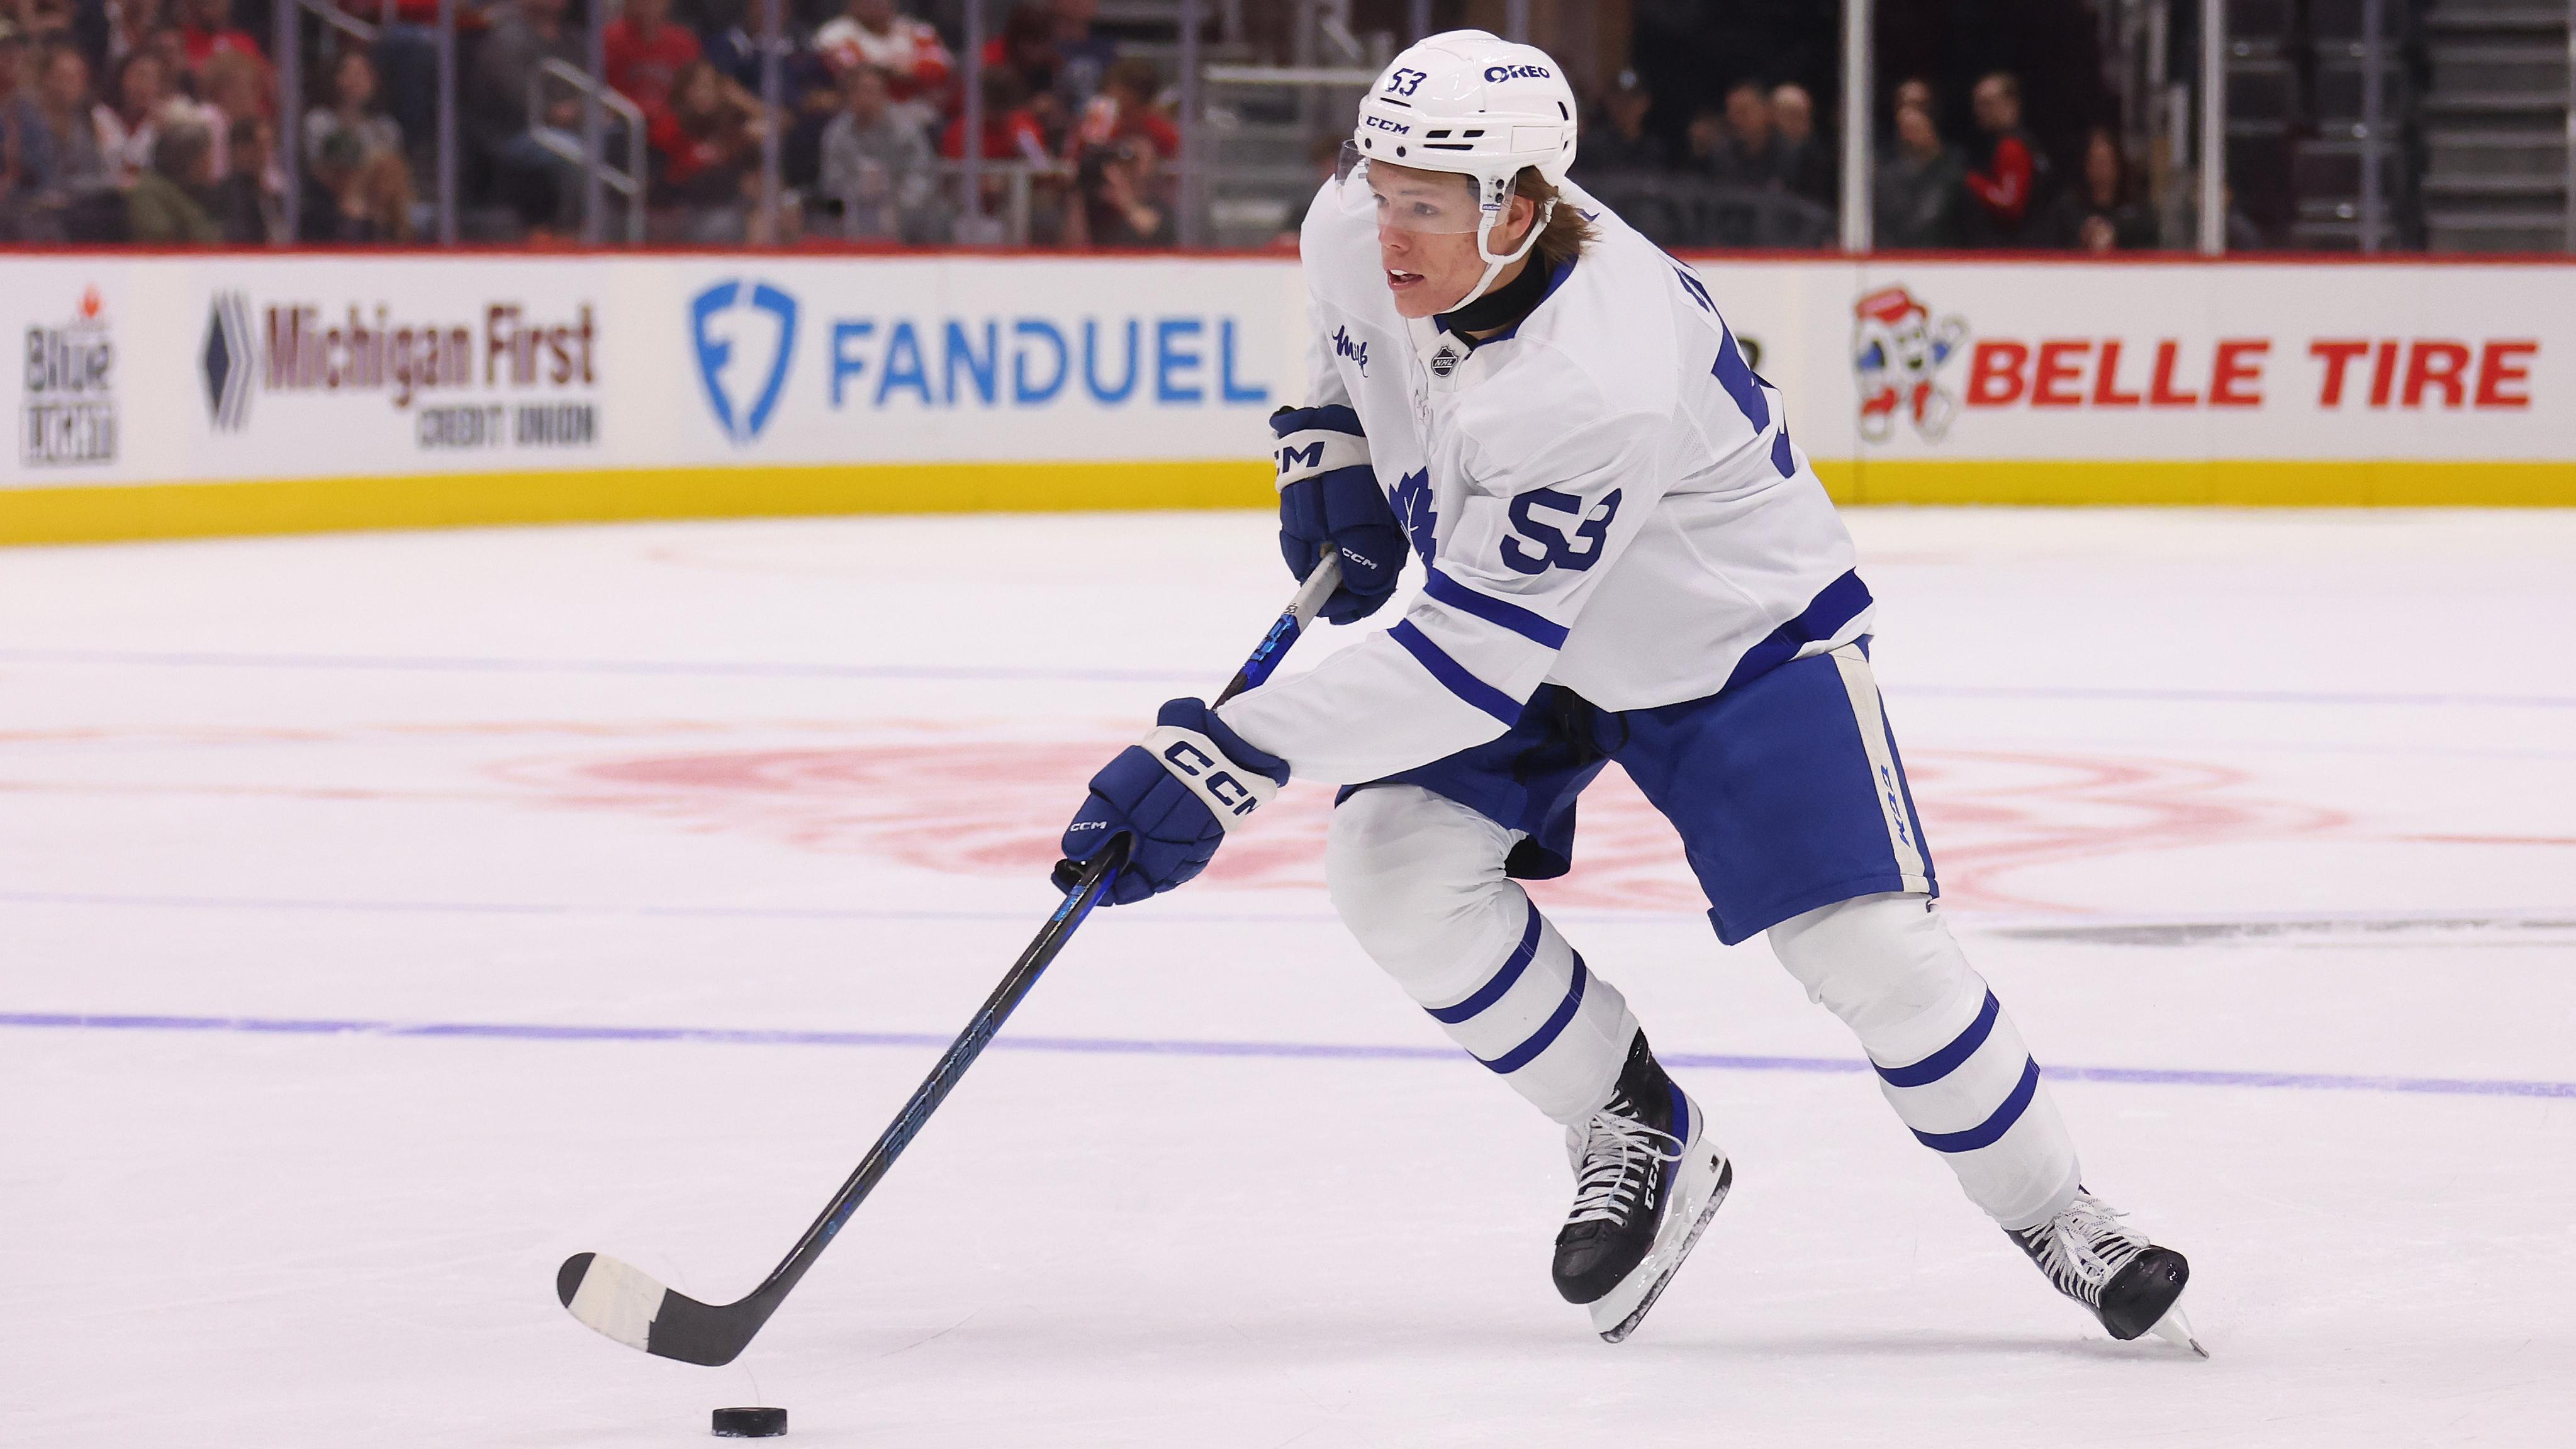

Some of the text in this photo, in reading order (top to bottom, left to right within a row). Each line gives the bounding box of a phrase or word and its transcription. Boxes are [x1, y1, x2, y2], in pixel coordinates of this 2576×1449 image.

[1385, 67, 1427, 96] 53
[1484, 65, 1550, 83] OREO
[1366, 115, 1410, 135] CCM
[264, 303, 593, 408] Michigan First
[829, 319, 1268, 406] FANDUEL
[1434, 359, 1453, 367] NHL
[1963, 338, 2540, 410] BELLE TIRE
[1499, 487, 1622, 575] 53
[1341, 547, 1378, 569] CCM
[1881, 764, 1911, 848] CCM
[1070, 820, 1107, 832] CCM
